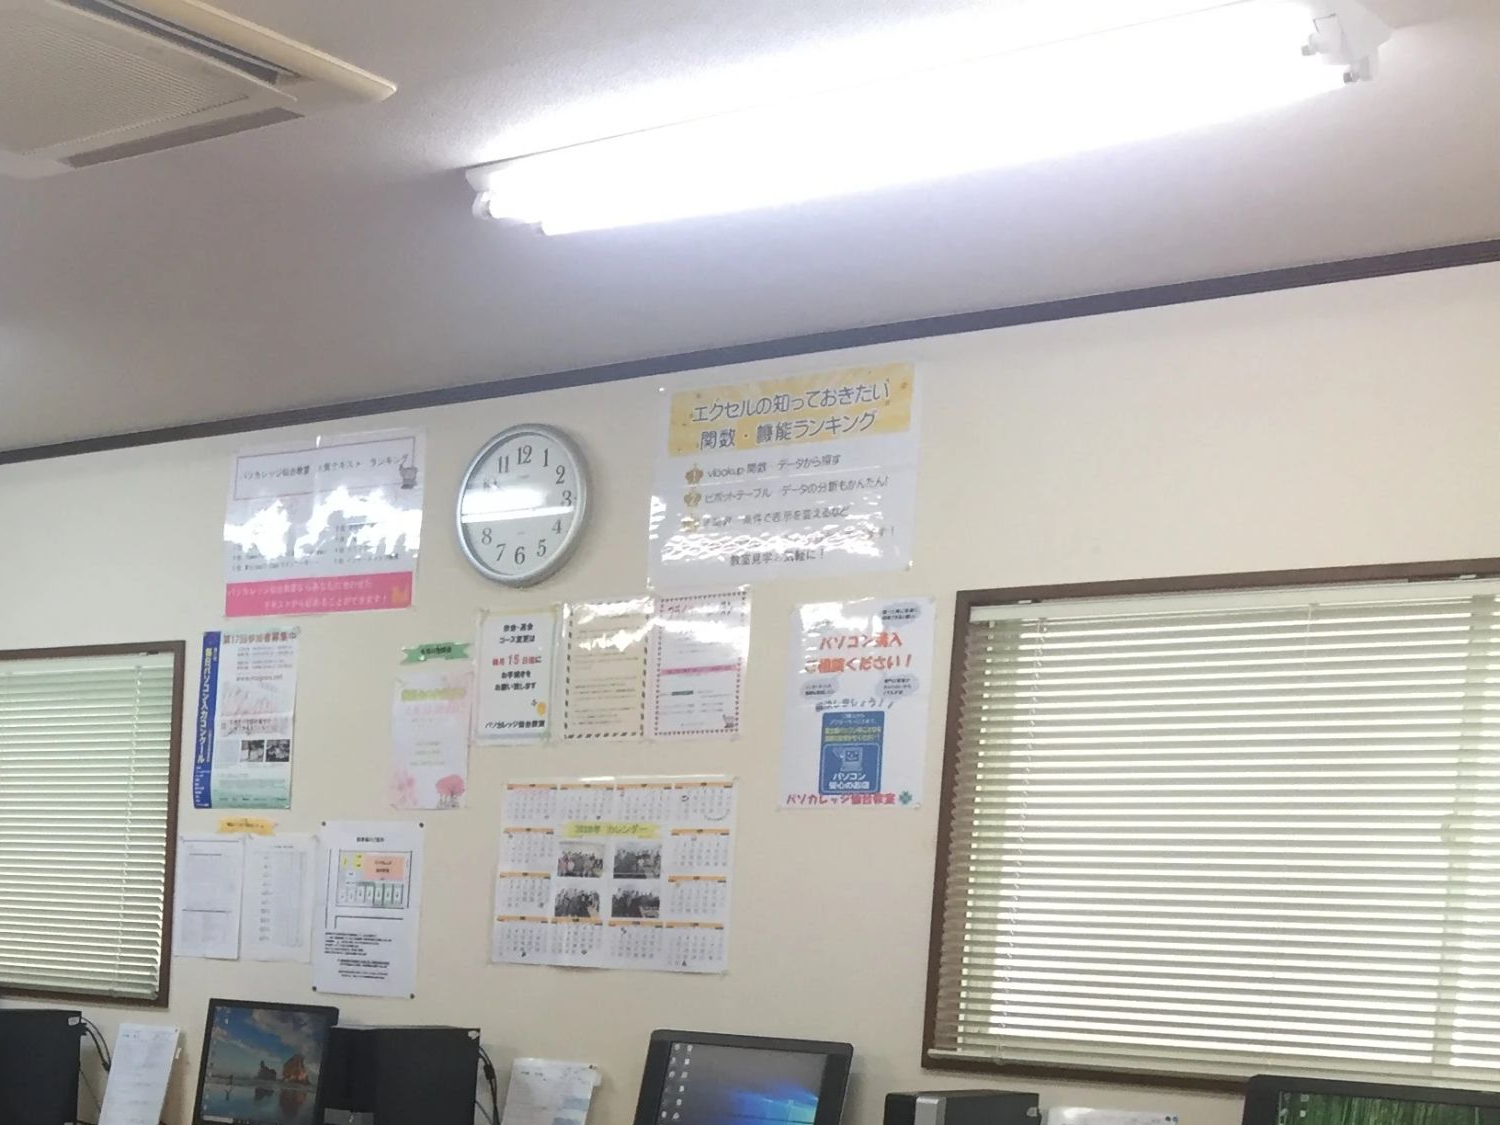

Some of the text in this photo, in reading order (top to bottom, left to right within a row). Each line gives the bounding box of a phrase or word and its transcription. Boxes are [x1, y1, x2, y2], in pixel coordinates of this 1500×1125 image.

[692, 382, 891, 423] エクセルの知っておきたい
[517, 445, 533, 464] 12
[542, 448, 549, 467] 1
[498, 455, 510, 473] 11
[555, 465, 566, 484] 2
[561, 490, 572, 507] 3
[551, 519, 562, 534] 4
[481, 528, 493, 545] 8
[495, 543, 506, 561] 7
[514, 546, 526, 564] 6
[536, 539, 547, 557] 5
[833, 772, 866, 781] パソコン
